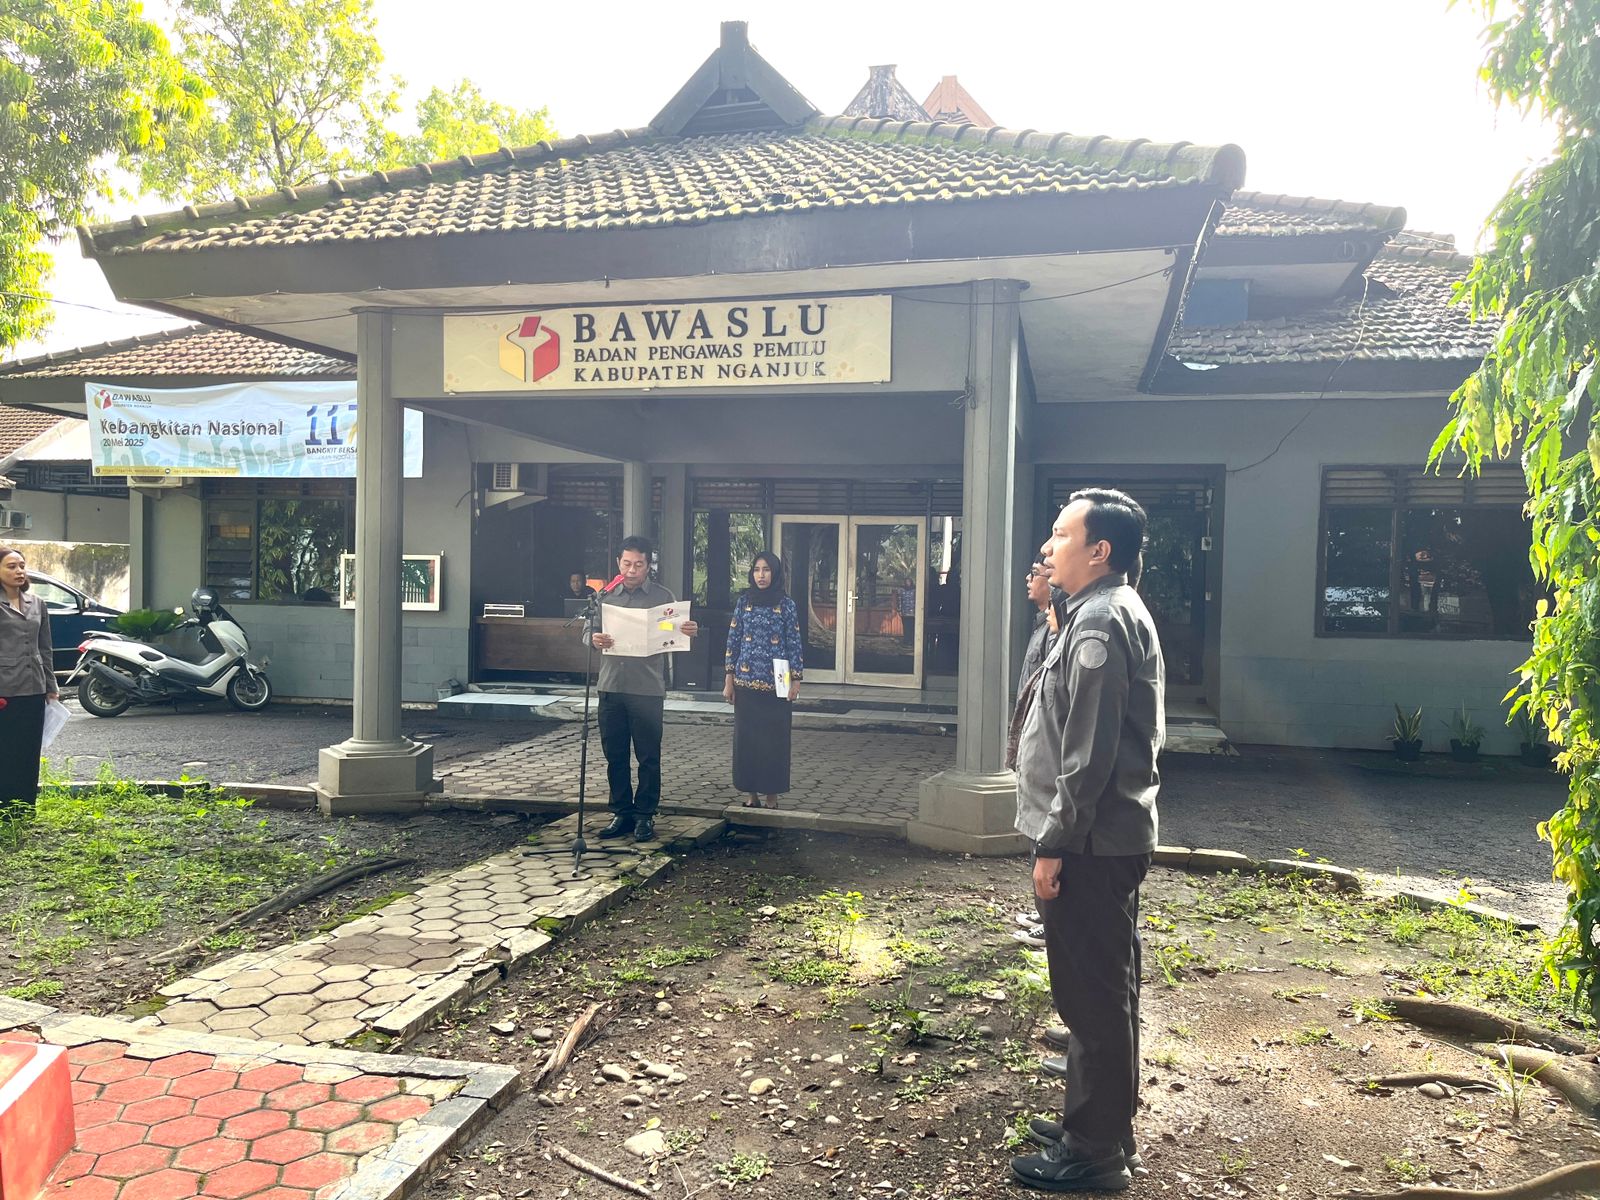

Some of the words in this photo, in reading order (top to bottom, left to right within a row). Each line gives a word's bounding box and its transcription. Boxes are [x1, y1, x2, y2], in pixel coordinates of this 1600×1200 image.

[573, 304, 828, 343] BAWASLU
[573, 347, 637, 363] BADAN
[648, 343, 743, 361] PENGAWAS
[753, 340, 827, 358] PEMILU
[574, 364, 705, 382] KABUPATEN
[717, 361, 827, 380] NGANJUK
[100, 418, 202, 440] Kebangkitan
[208, 418, 284, 436] Nasional
[103, 438, 112, 447] 20
[112, 438, 124, 447] Mei
[124, 438, 144, 447] 2025
